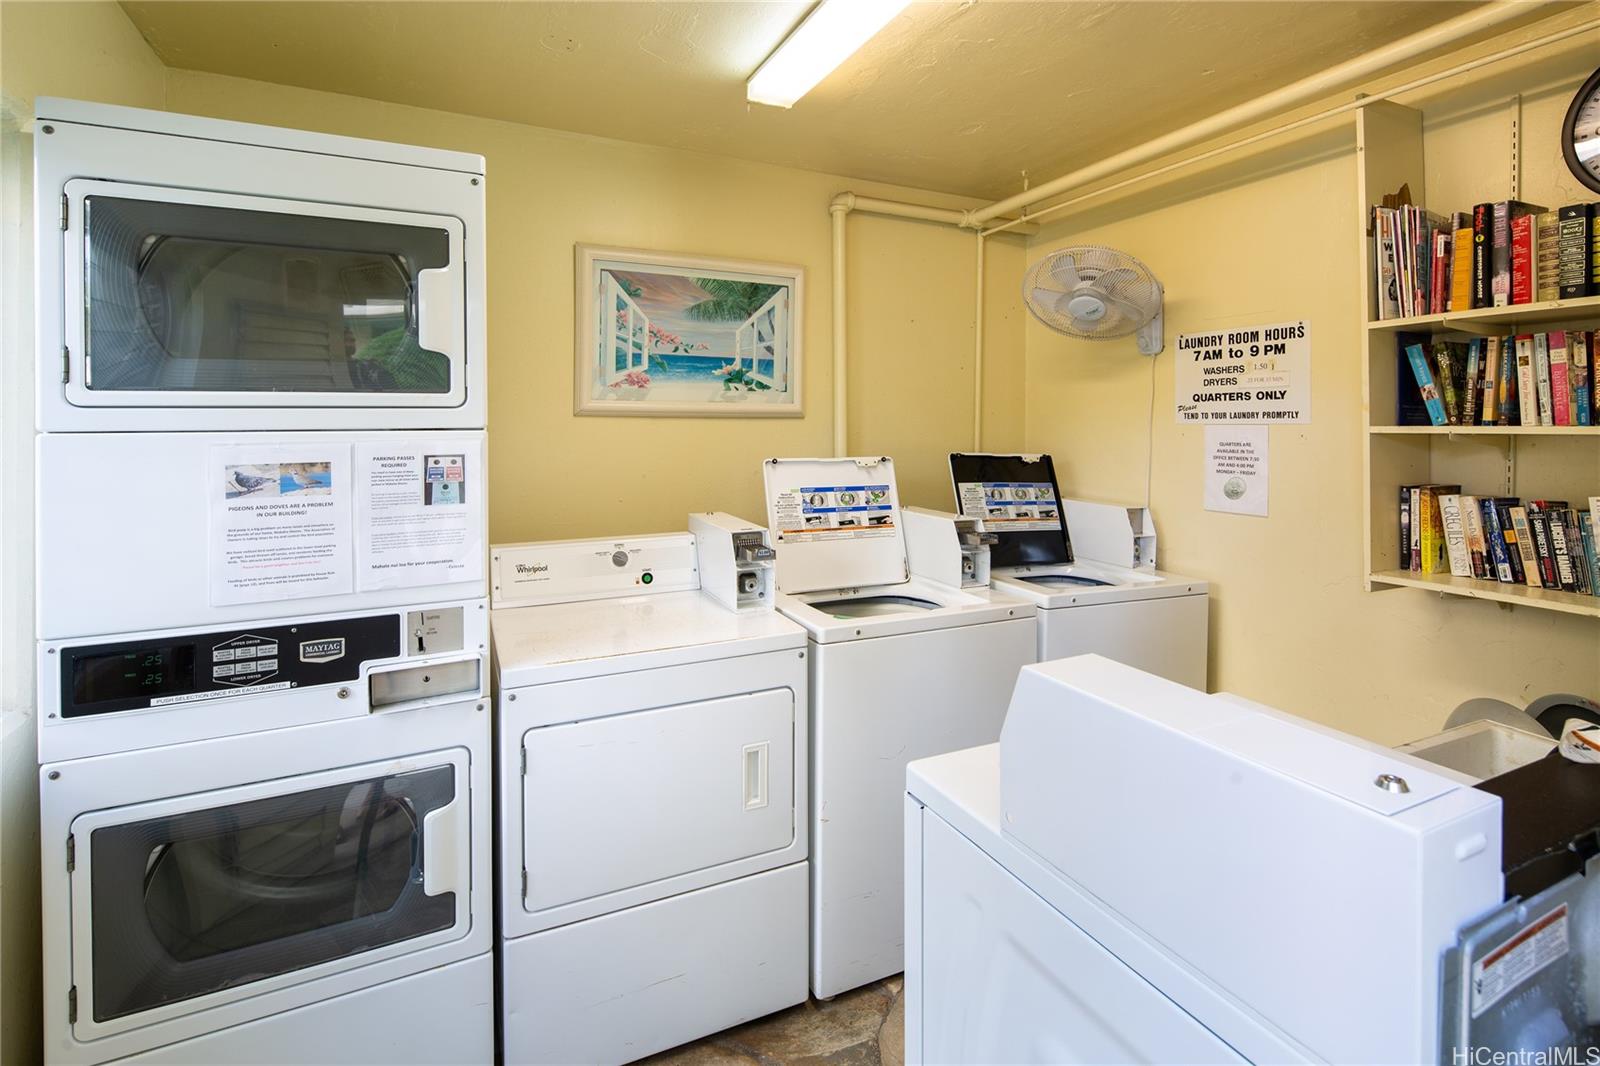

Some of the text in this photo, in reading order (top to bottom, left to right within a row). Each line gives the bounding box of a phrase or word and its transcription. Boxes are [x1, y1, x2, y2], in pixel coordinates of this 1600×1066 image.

[1179, 326, 1304, 350] LAUNDRY ROOM HOURS
[1228, 348, 1244, 359] to
[1203, 364, 1245, 375] WASHERS
[1203, 378, 1238, 387] DRYERS
[1192, 390, 1287, 402] QUARTERS ONLY
[1177, 404, 1198, 413] Please
[1550, 522, 1574, 584] LUCIFER'S HAMMER
[516, 564, 548, 574] Whirlpool
[305, 643, 340, 653] MAYTAG
[174, 693, 209, 702] SELECTION
